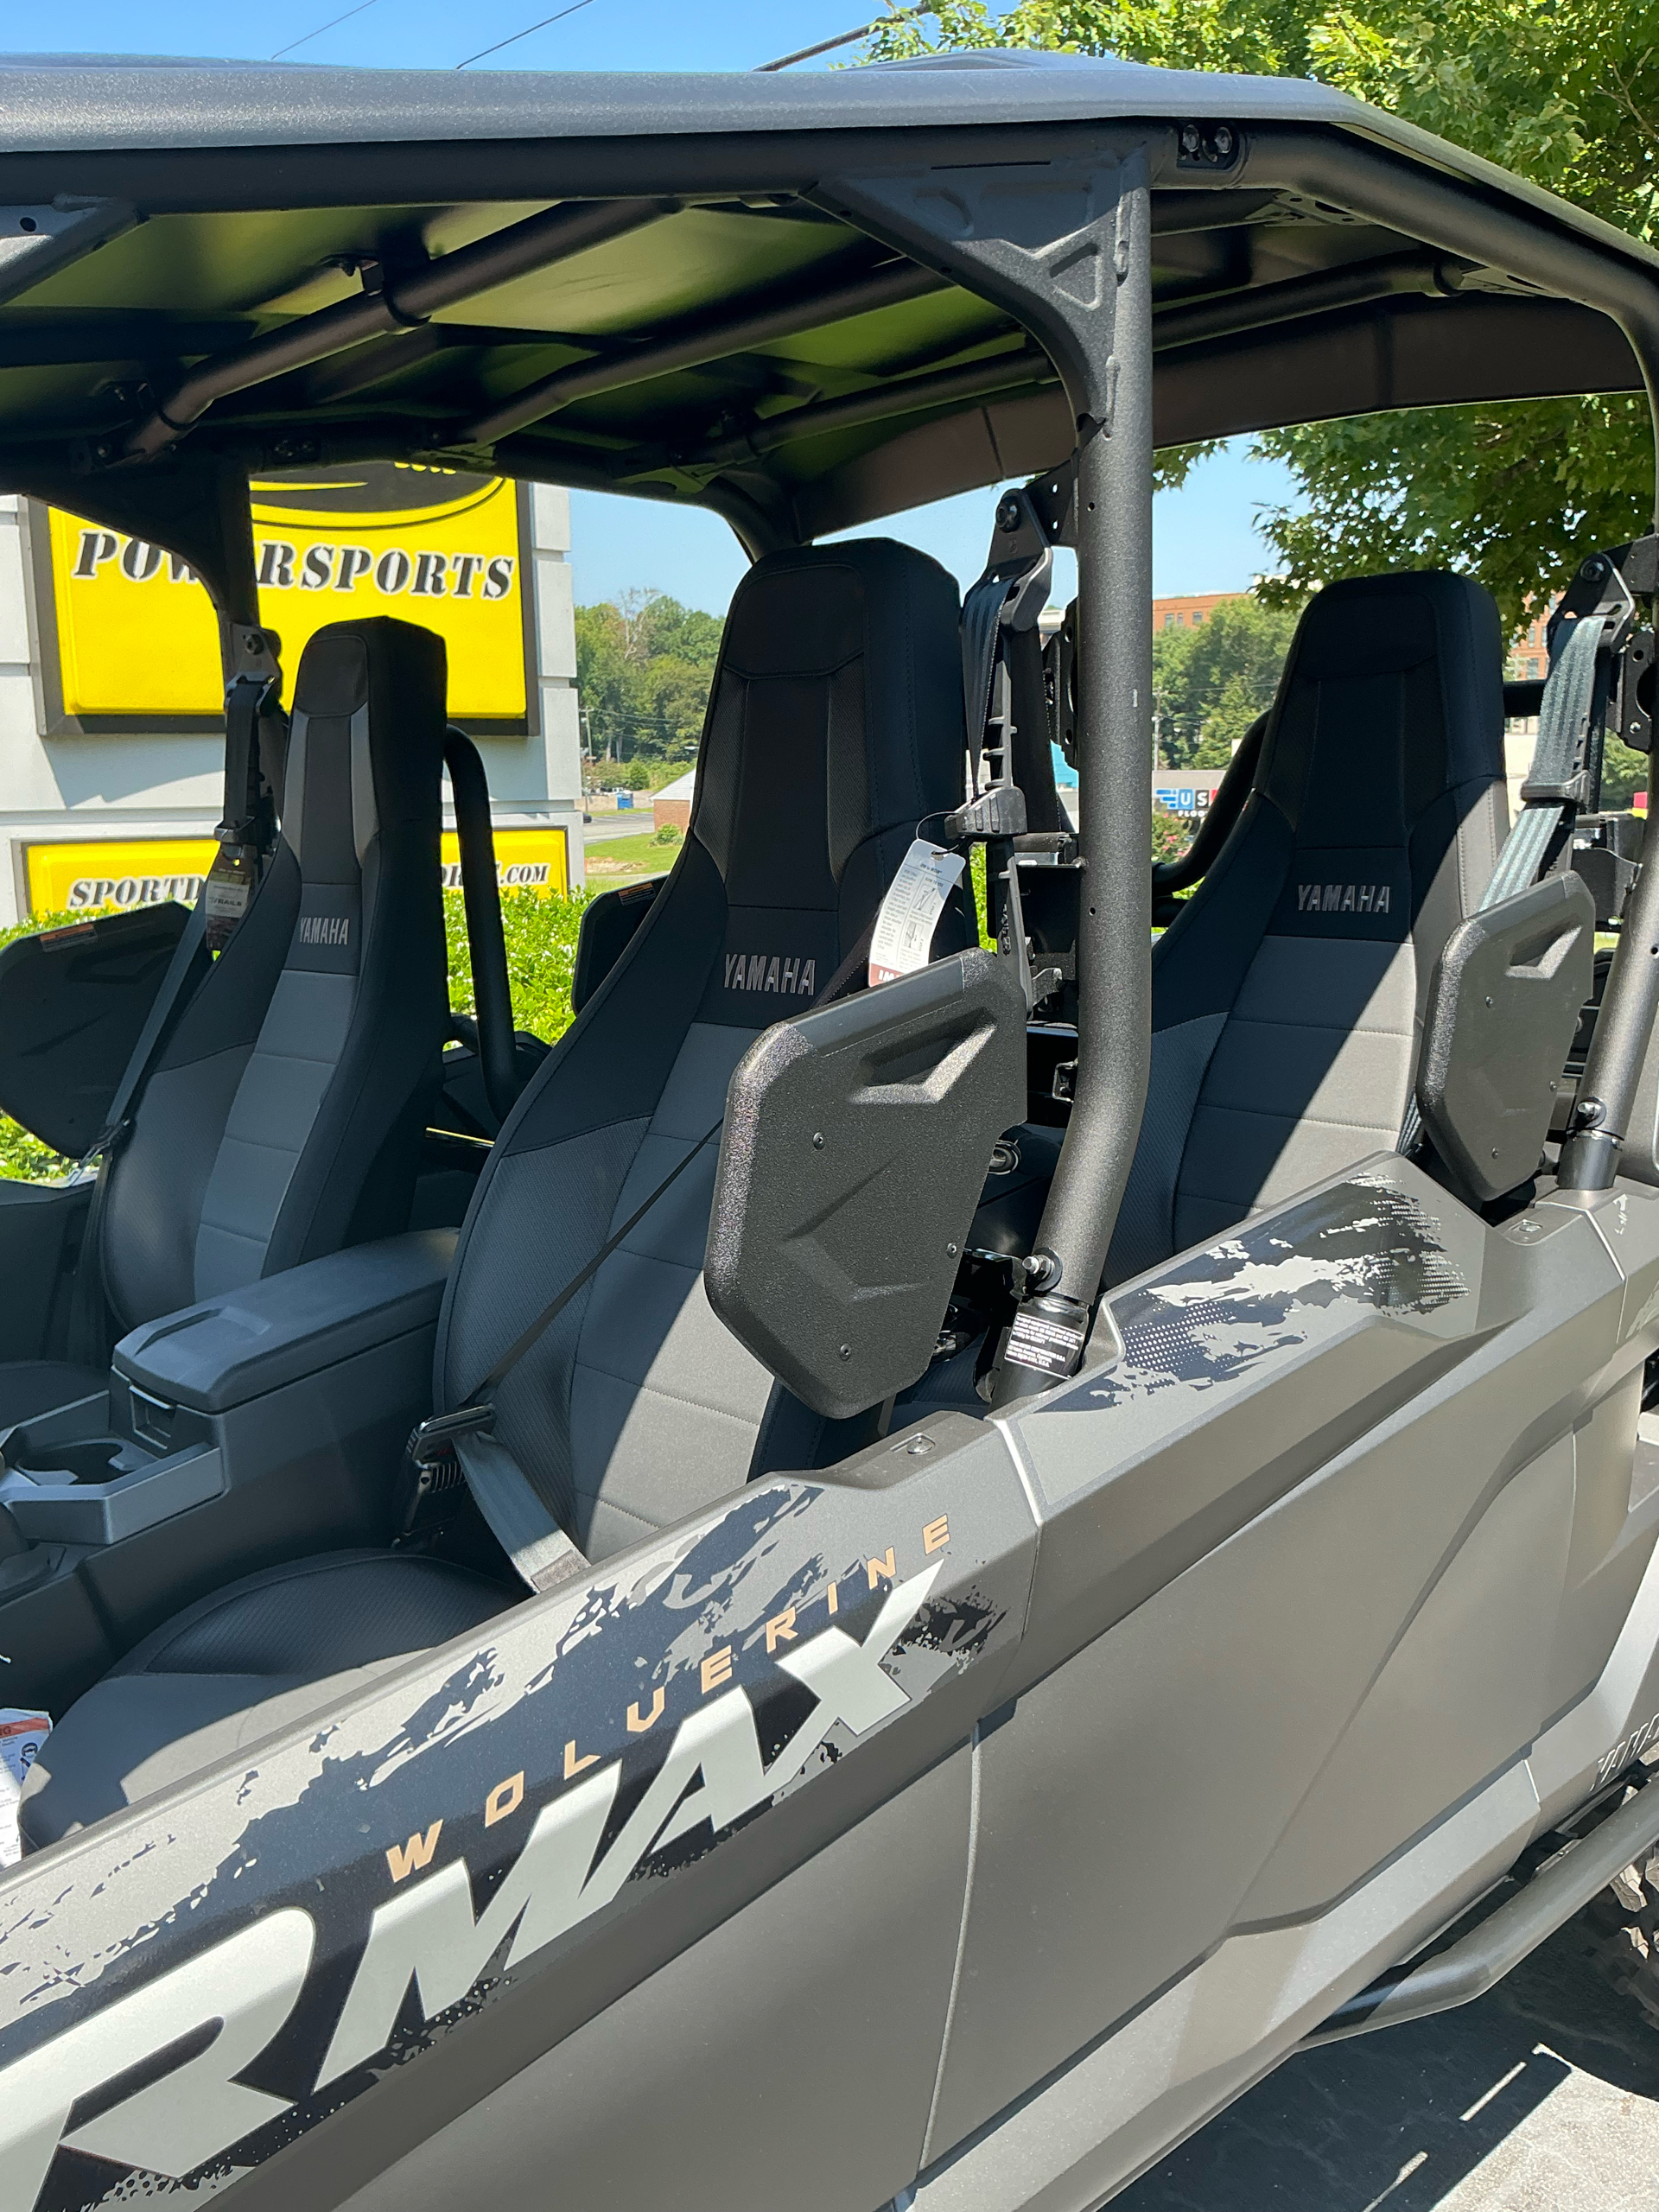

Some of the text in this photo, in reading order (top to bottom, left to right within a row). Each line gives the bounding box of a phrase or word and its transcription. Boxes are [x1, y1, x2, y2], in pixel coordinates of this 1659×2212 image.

[1178, 810, 1209, 818] FLOO
[1298, 884, 1389, 913] YAMAHA
[299, 917, 349, 945] YAMAHA
[724, 953, 816, 995] YAMAHA
[385, 1513, 950, 1883] WOLVERINE
